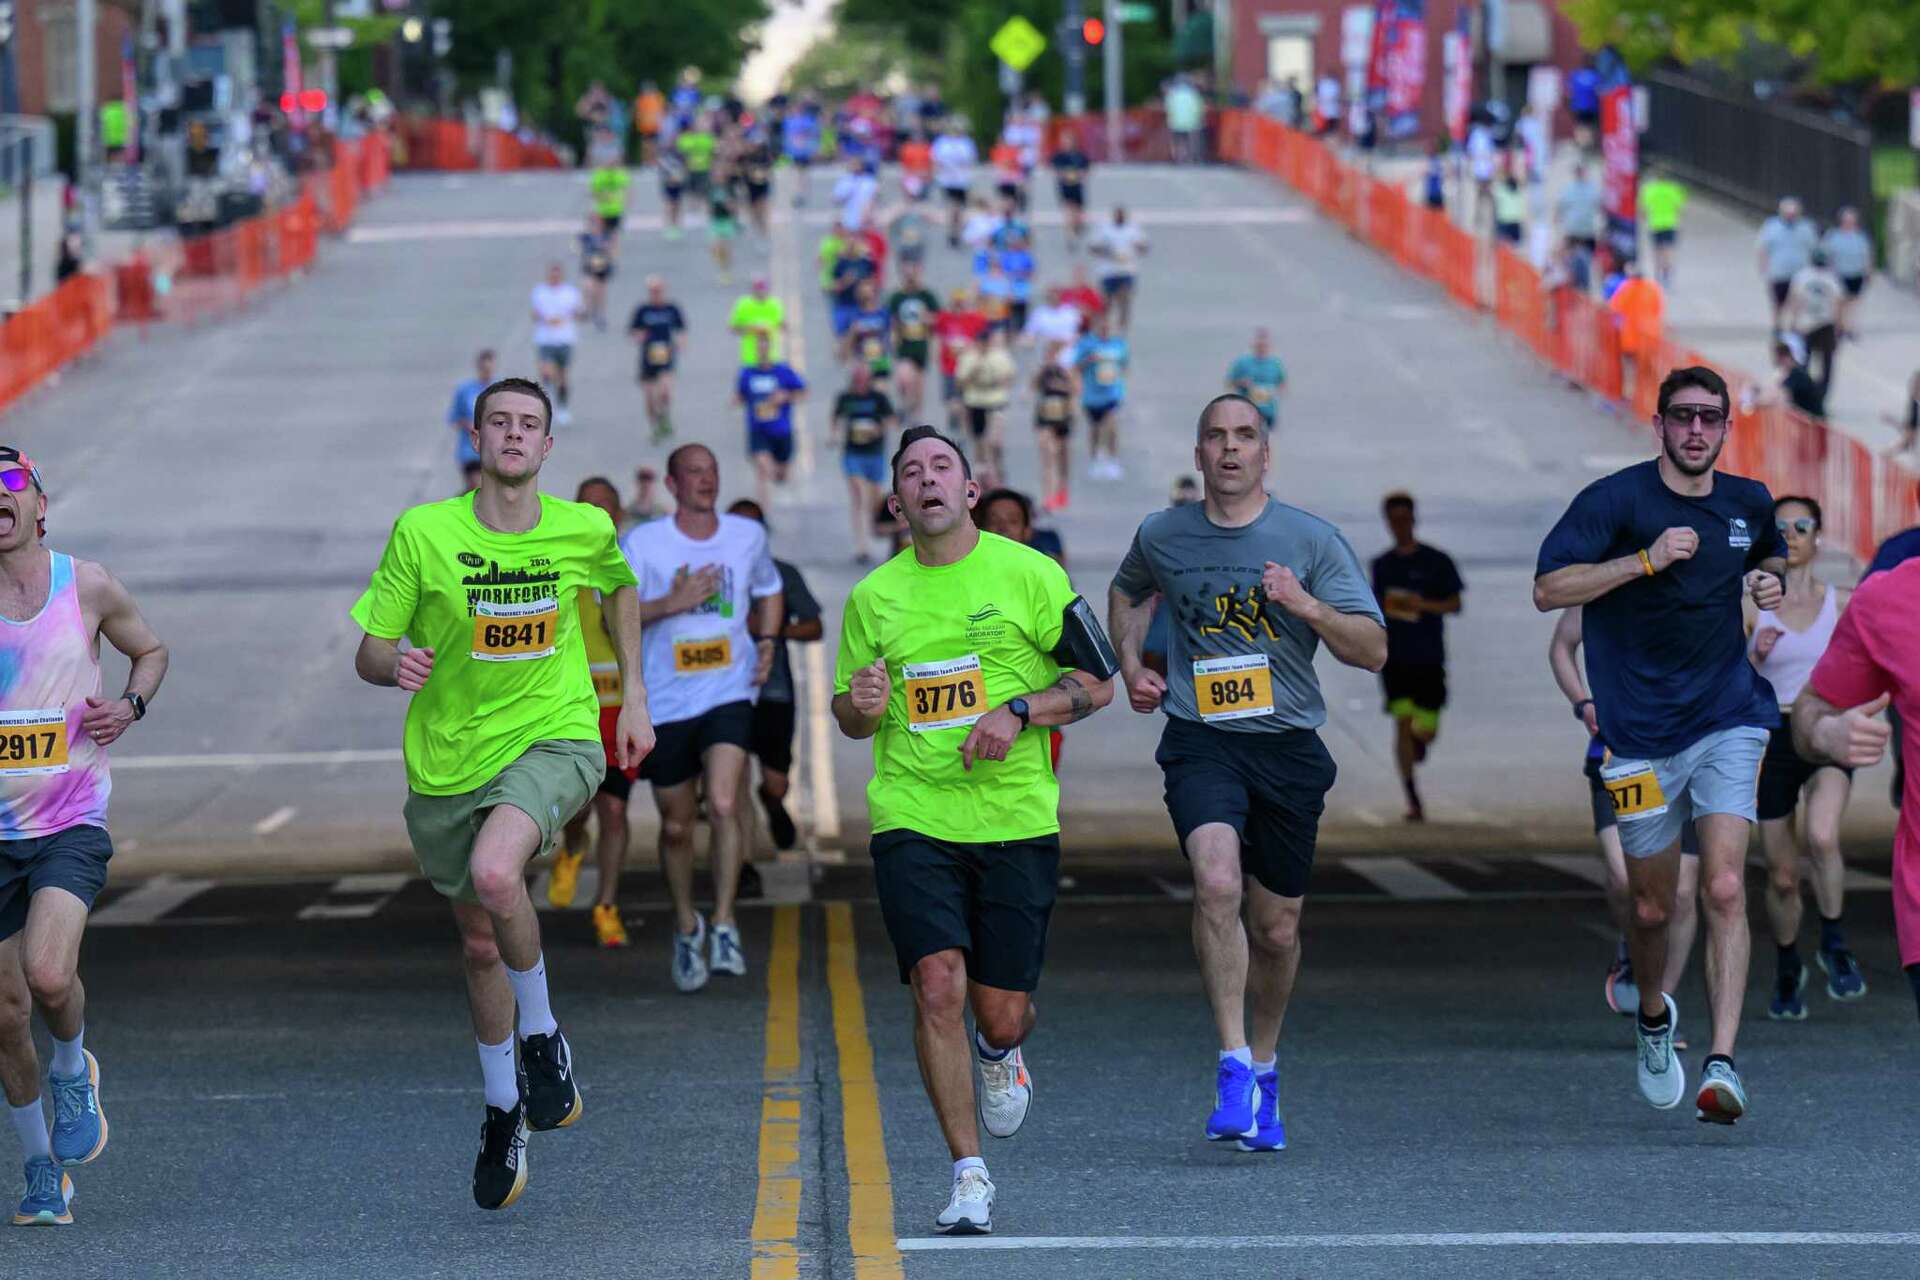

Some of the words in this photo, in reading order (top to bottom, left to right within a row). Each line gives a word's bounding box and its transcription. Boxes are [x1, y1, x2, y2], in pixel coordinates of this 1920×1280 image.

[529, 558, 551, 567] 2024
[466, 584, 560, 606] WORKFORCE
[484, 621, 546, 648] 6841
[940, 667, 953, 675] Team
[954, 663, 979, 673] Challenge
[915, 680, 977, 714] 3776
[1210, 677, 1254, 706] 984
[40, 716, 64, 724] Challenge
[0, 732, 57, 760] 2917
